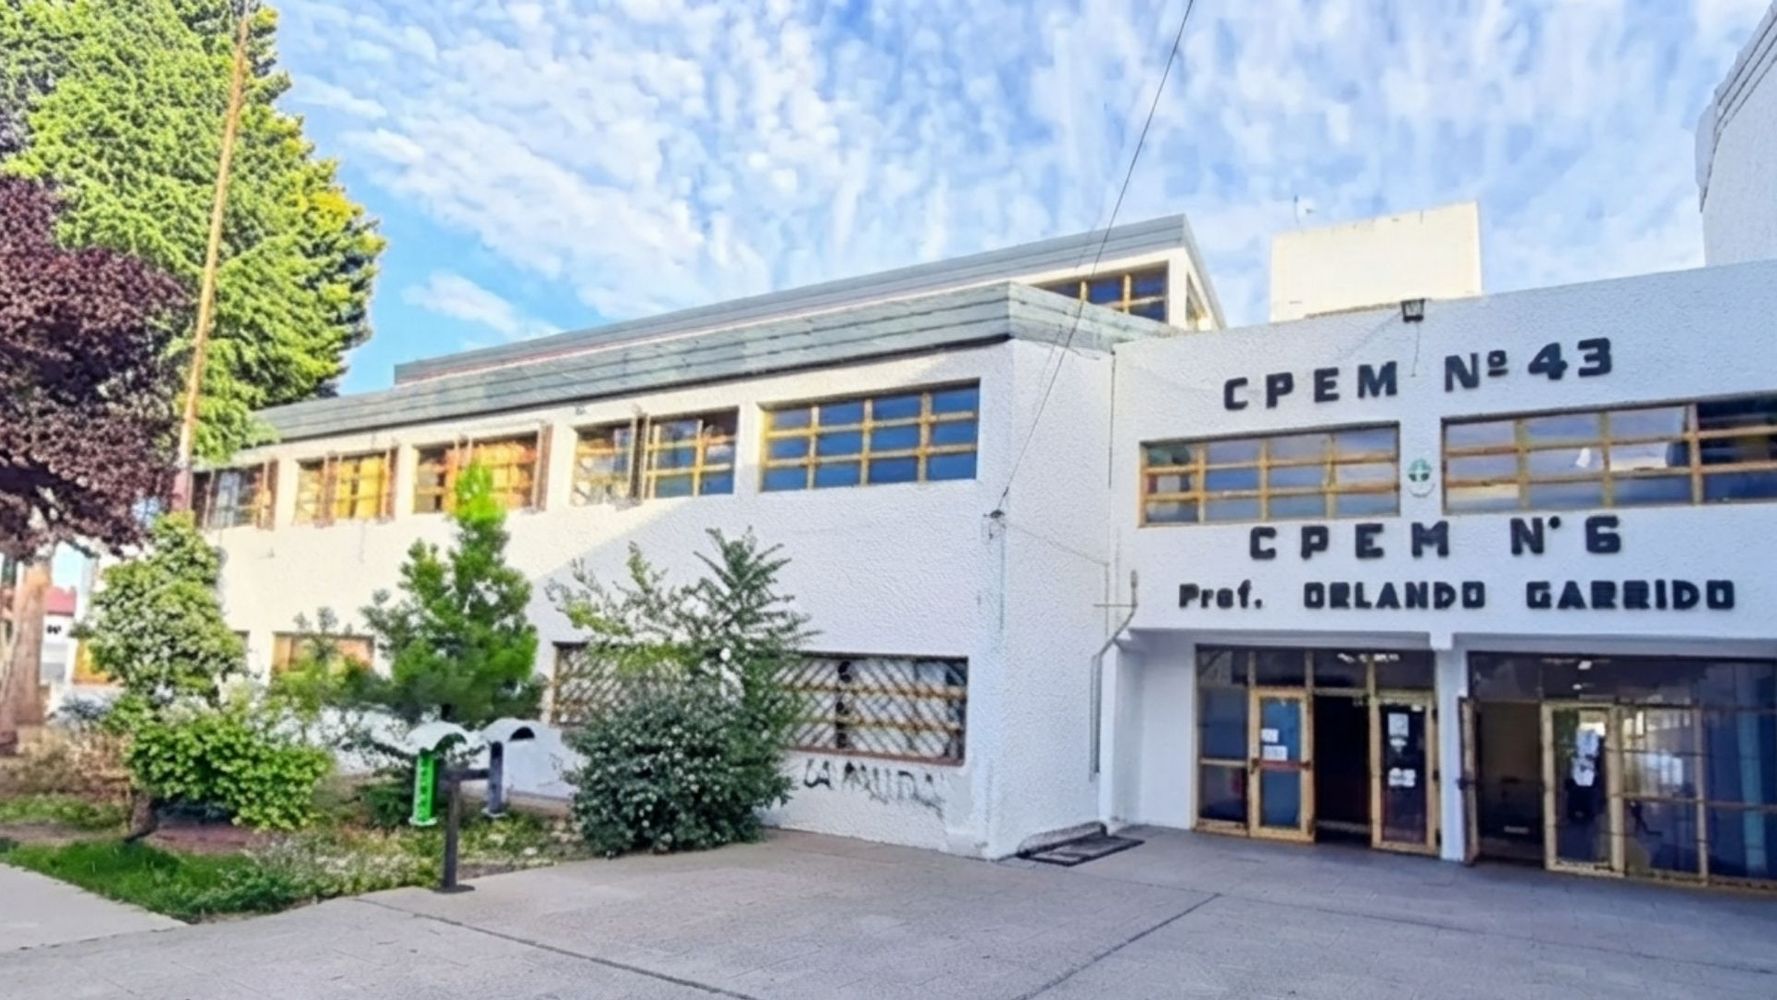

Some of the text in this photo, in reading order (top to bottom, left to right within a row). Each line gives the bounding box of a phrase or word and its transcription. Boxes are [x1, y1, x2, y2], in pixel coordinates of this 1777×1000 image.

[1223, 360, 1399, 412] CPEM
[1526, 336, 1614, 382] 43
[1249, 520, 1450, 562] CPEM
[1584, 514, 1622, 555] 6
[1177, 578, 1737, 613] Prof. ORLANDO GARRIDO
